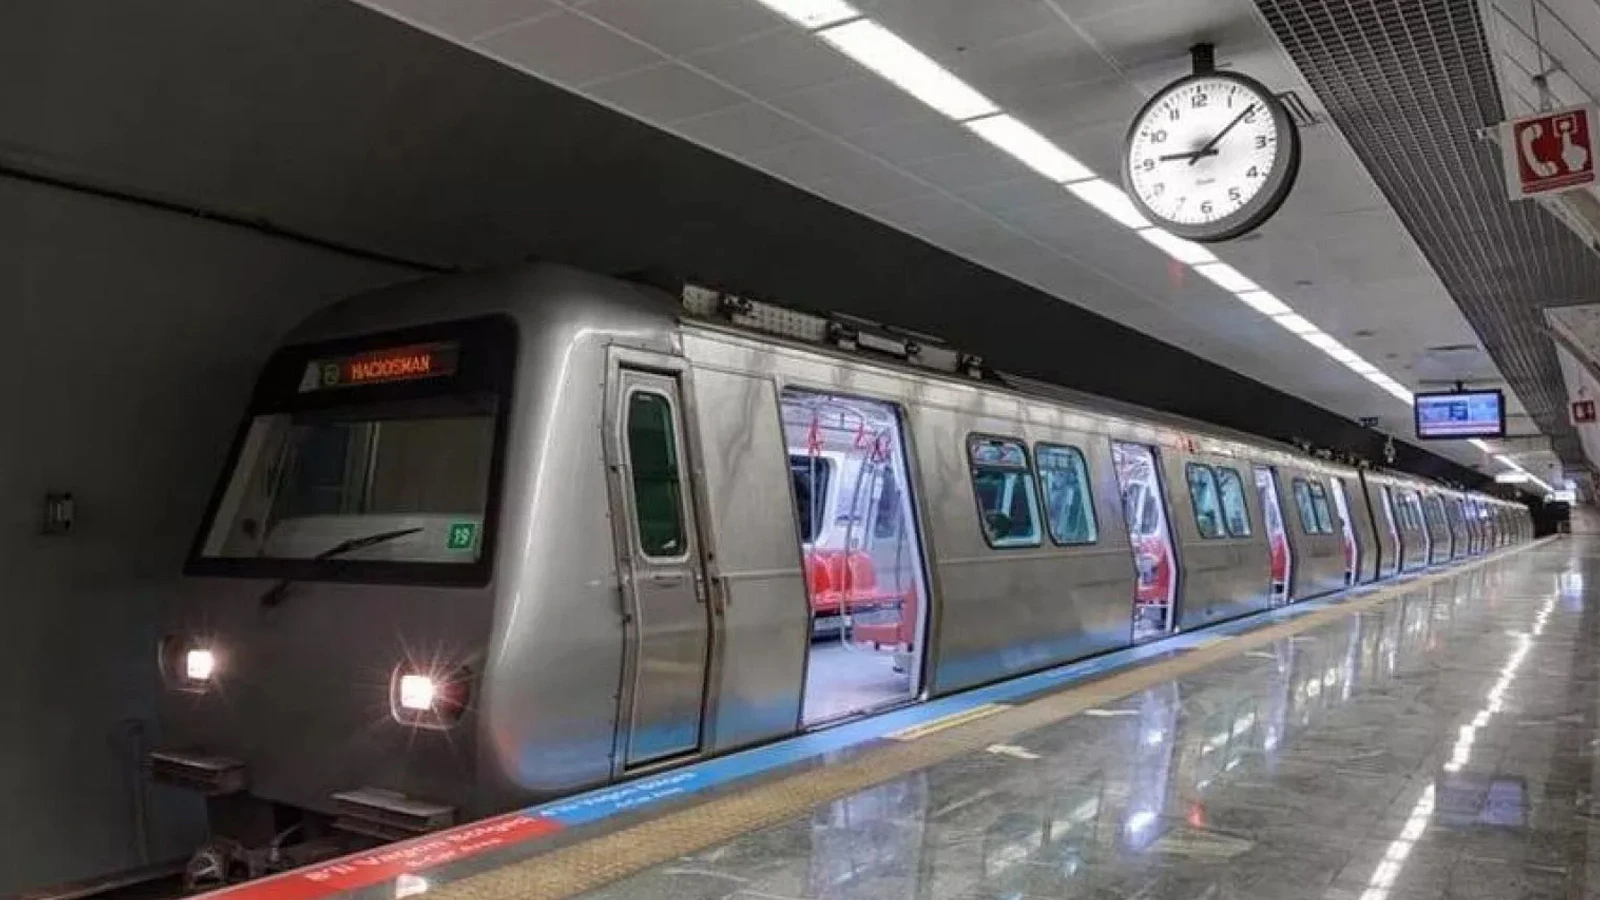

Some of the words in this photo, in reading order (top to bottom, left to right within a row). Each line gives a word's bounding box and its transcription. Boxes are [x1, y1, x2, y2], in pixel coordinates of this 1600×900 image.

[1192, 94, 1207, 107] 12
[1169, 109, 1180, 120] 11
[1151, 130, 1167, 142] 10
[1255, 135, 1267, 149] 3
[1143, 159, 1155, 171] 9
[1246, 166, 1258, 178] 4
[1228, 187, 1241, 200] 5
[1201, 202, 1213, 214] 6
